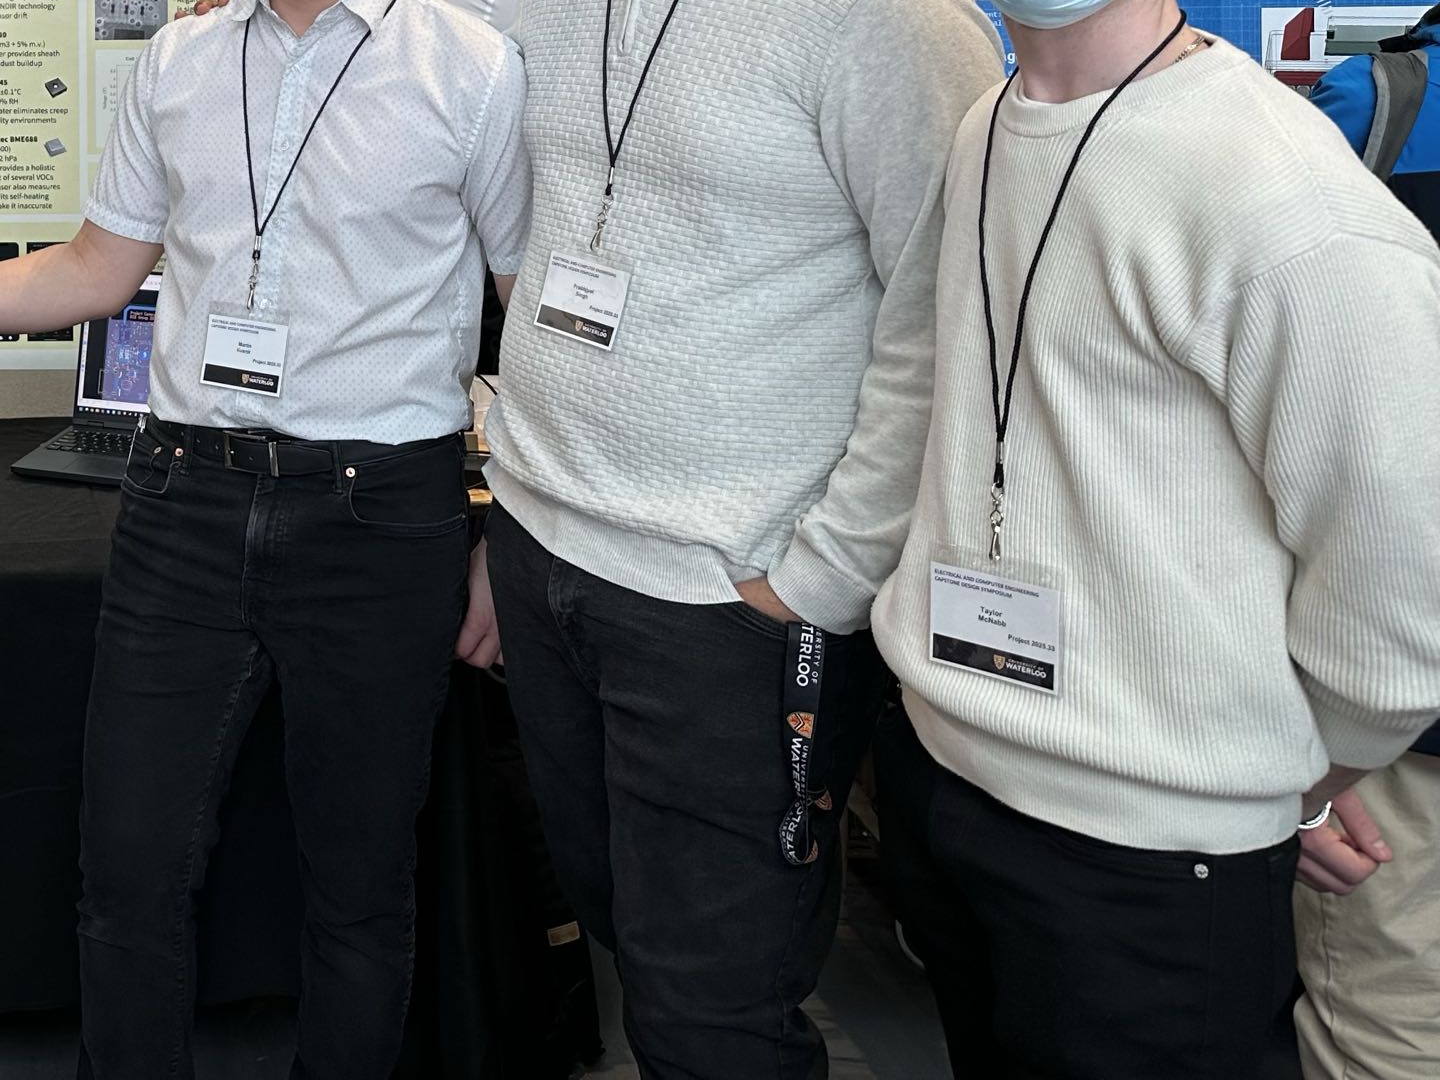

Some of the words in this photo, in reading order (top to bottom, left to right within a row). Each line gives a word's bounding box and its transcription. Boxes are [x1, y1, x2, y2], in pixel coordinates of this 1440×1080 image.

[18, 3, 55, 11] technology
[7, 50, 36, 58] provides
[17, 60, 42, 68] buildup
[935, 568, 962, 579] ELECTRICAL
[976, 578, 1004, 589] COMPUTER
[1005, 584, 1039, 597] ENGINEERING
[935, 576, 959, 586] CAPSTONE
[961, 583, 980, 591] DESIGN
[981, 587, 1012, 598] SYMPOSIUM
[980, 606, 1002, 618] Taylor
[978, 615, 1006, 627] McNabb
[1008, 634, 1030, 645] Project
[813, 630, 822, 666] ERSITY
[796, 626, 814, 686] TERLOO
[1008, 659, 1036, 668] UNIVERSITY
[1006, 662, 1046, 678] WATERLOO
[791, 738, 803, 797] WATER
